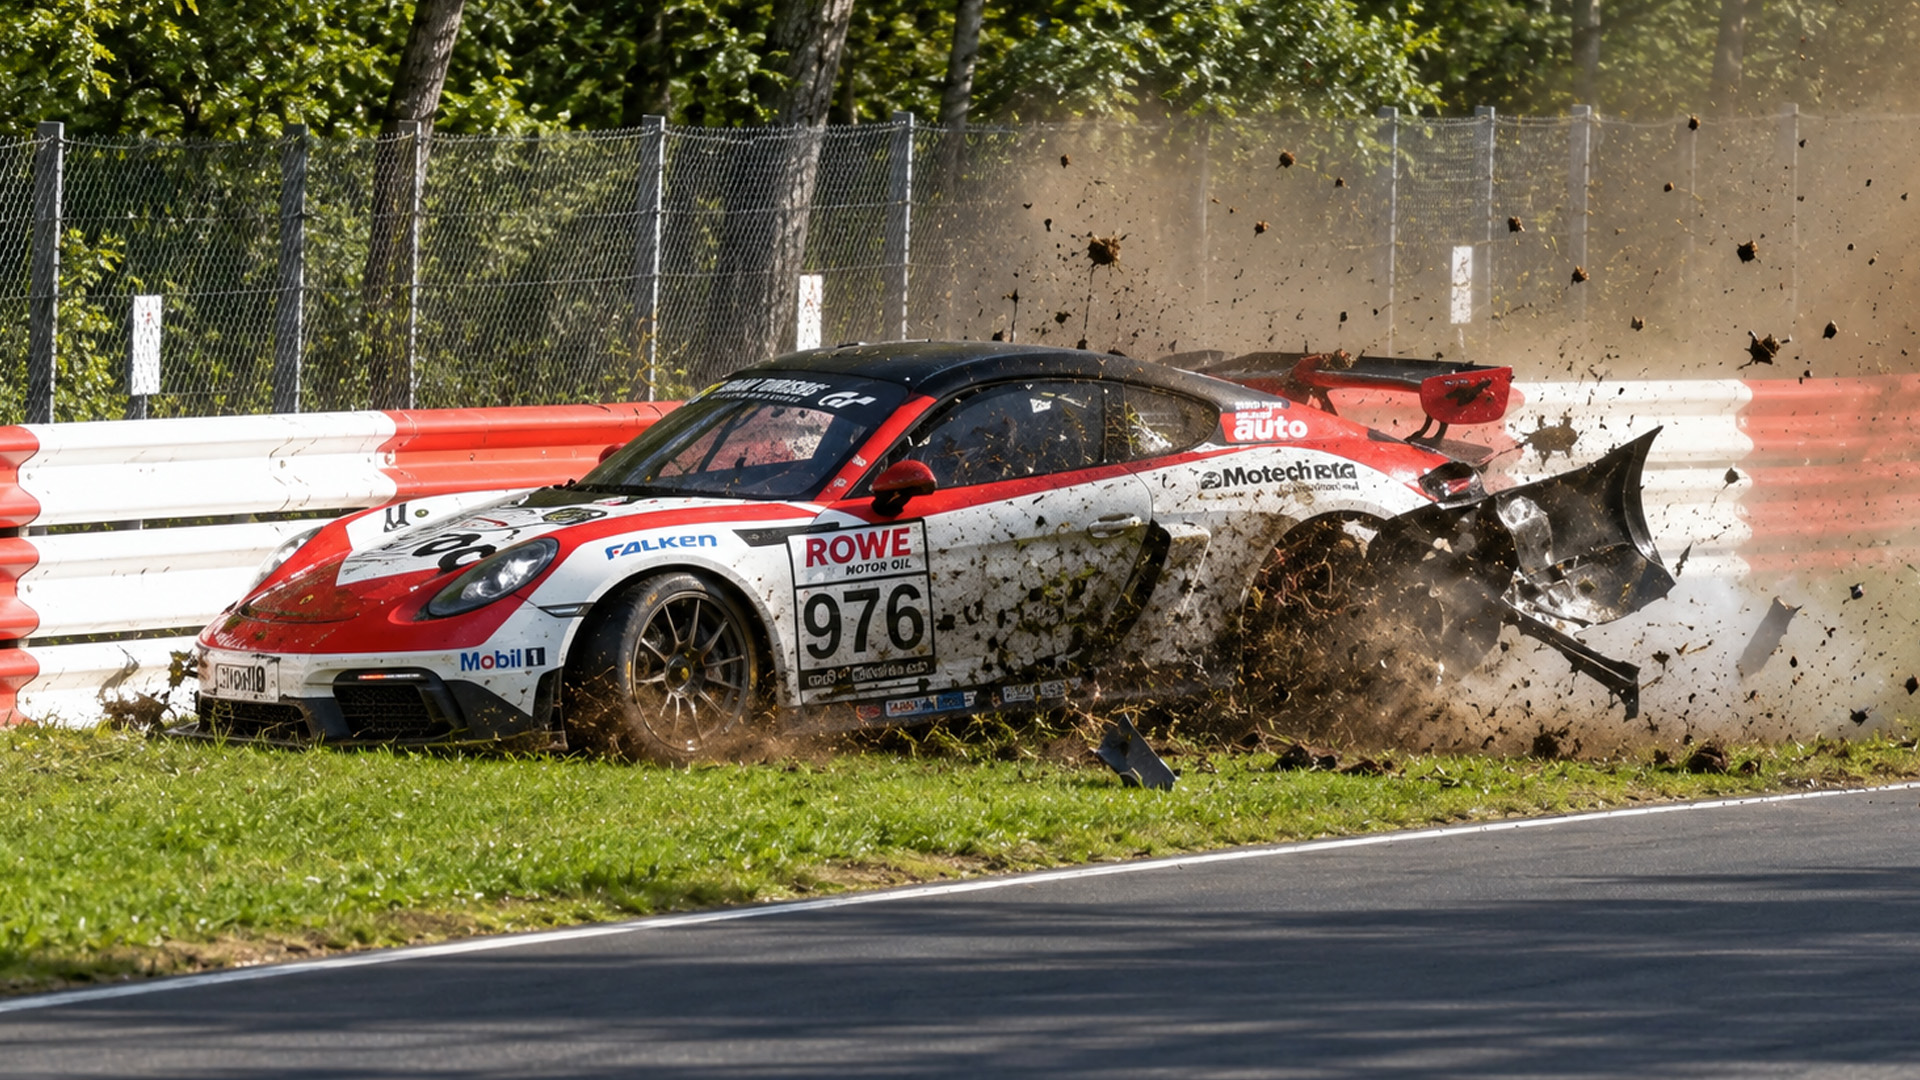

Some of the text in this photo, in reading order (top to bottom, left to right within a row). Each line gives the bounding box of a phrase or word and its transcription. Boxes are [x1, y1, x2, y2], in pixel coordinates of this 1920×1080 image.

[1233, 415, 1308, 440] auto
[1223, 461, 1311, 487] Motech
[805, 526, 911, 568] ROWE
[846, 558, 912, 576] MOTOR OIL
[803, 583, 924, 660] 976
[460, 648, 522, 671] Mobil
